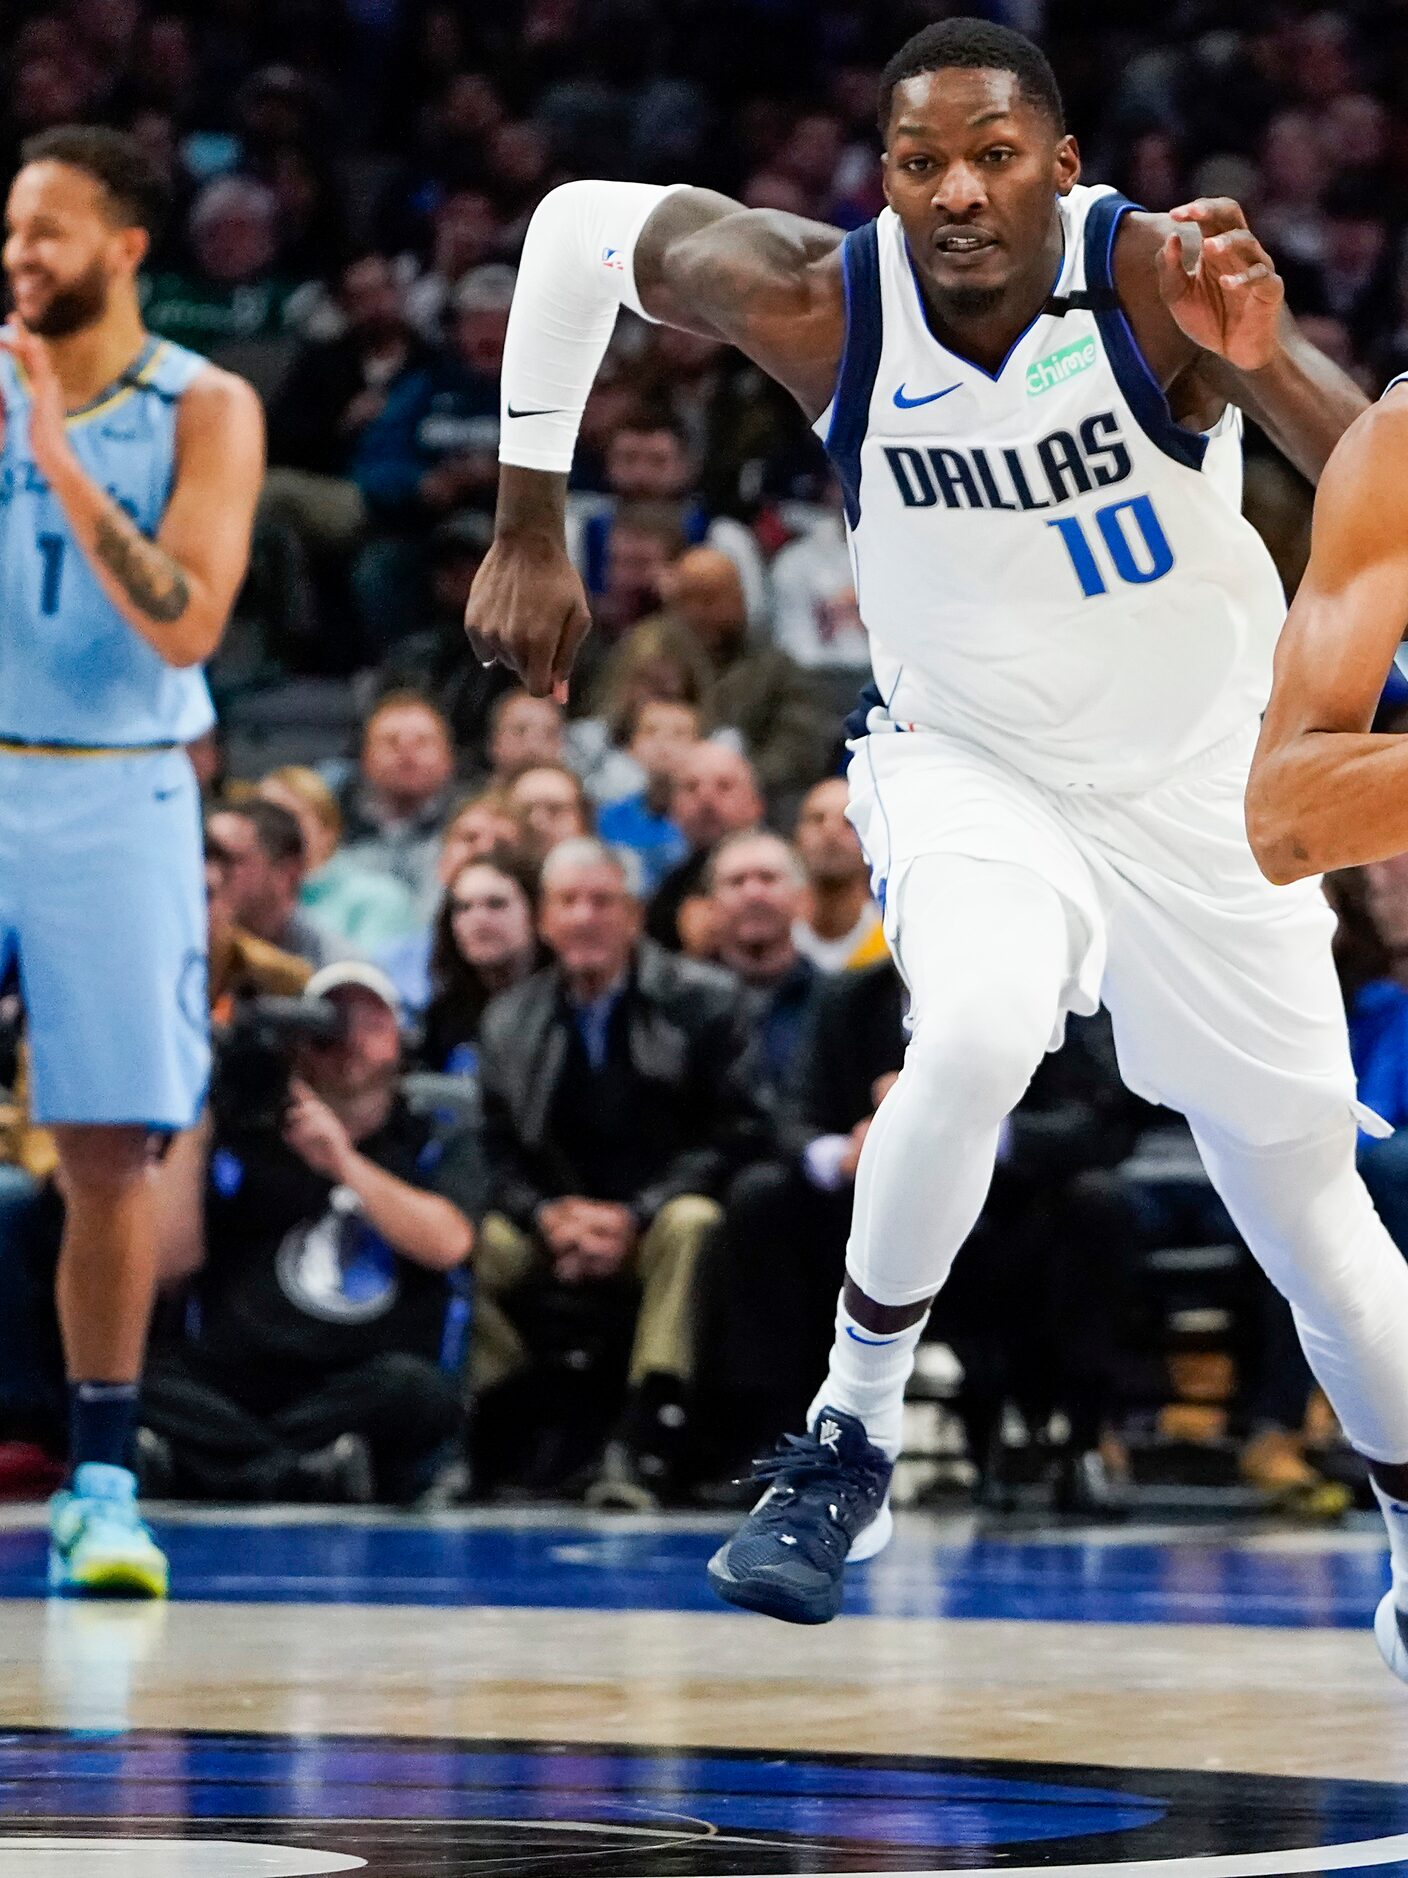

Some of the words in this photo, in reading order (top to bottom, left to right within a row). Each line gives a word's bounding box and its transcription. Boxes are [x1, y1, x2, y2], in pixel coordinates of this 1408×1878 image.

[1027, 341, 1096, 393] chime
[881, 410, 1134, 511] DALLAS
[36, 531, 66, 617] 1
[1044, 491, 1175, 600] 10
